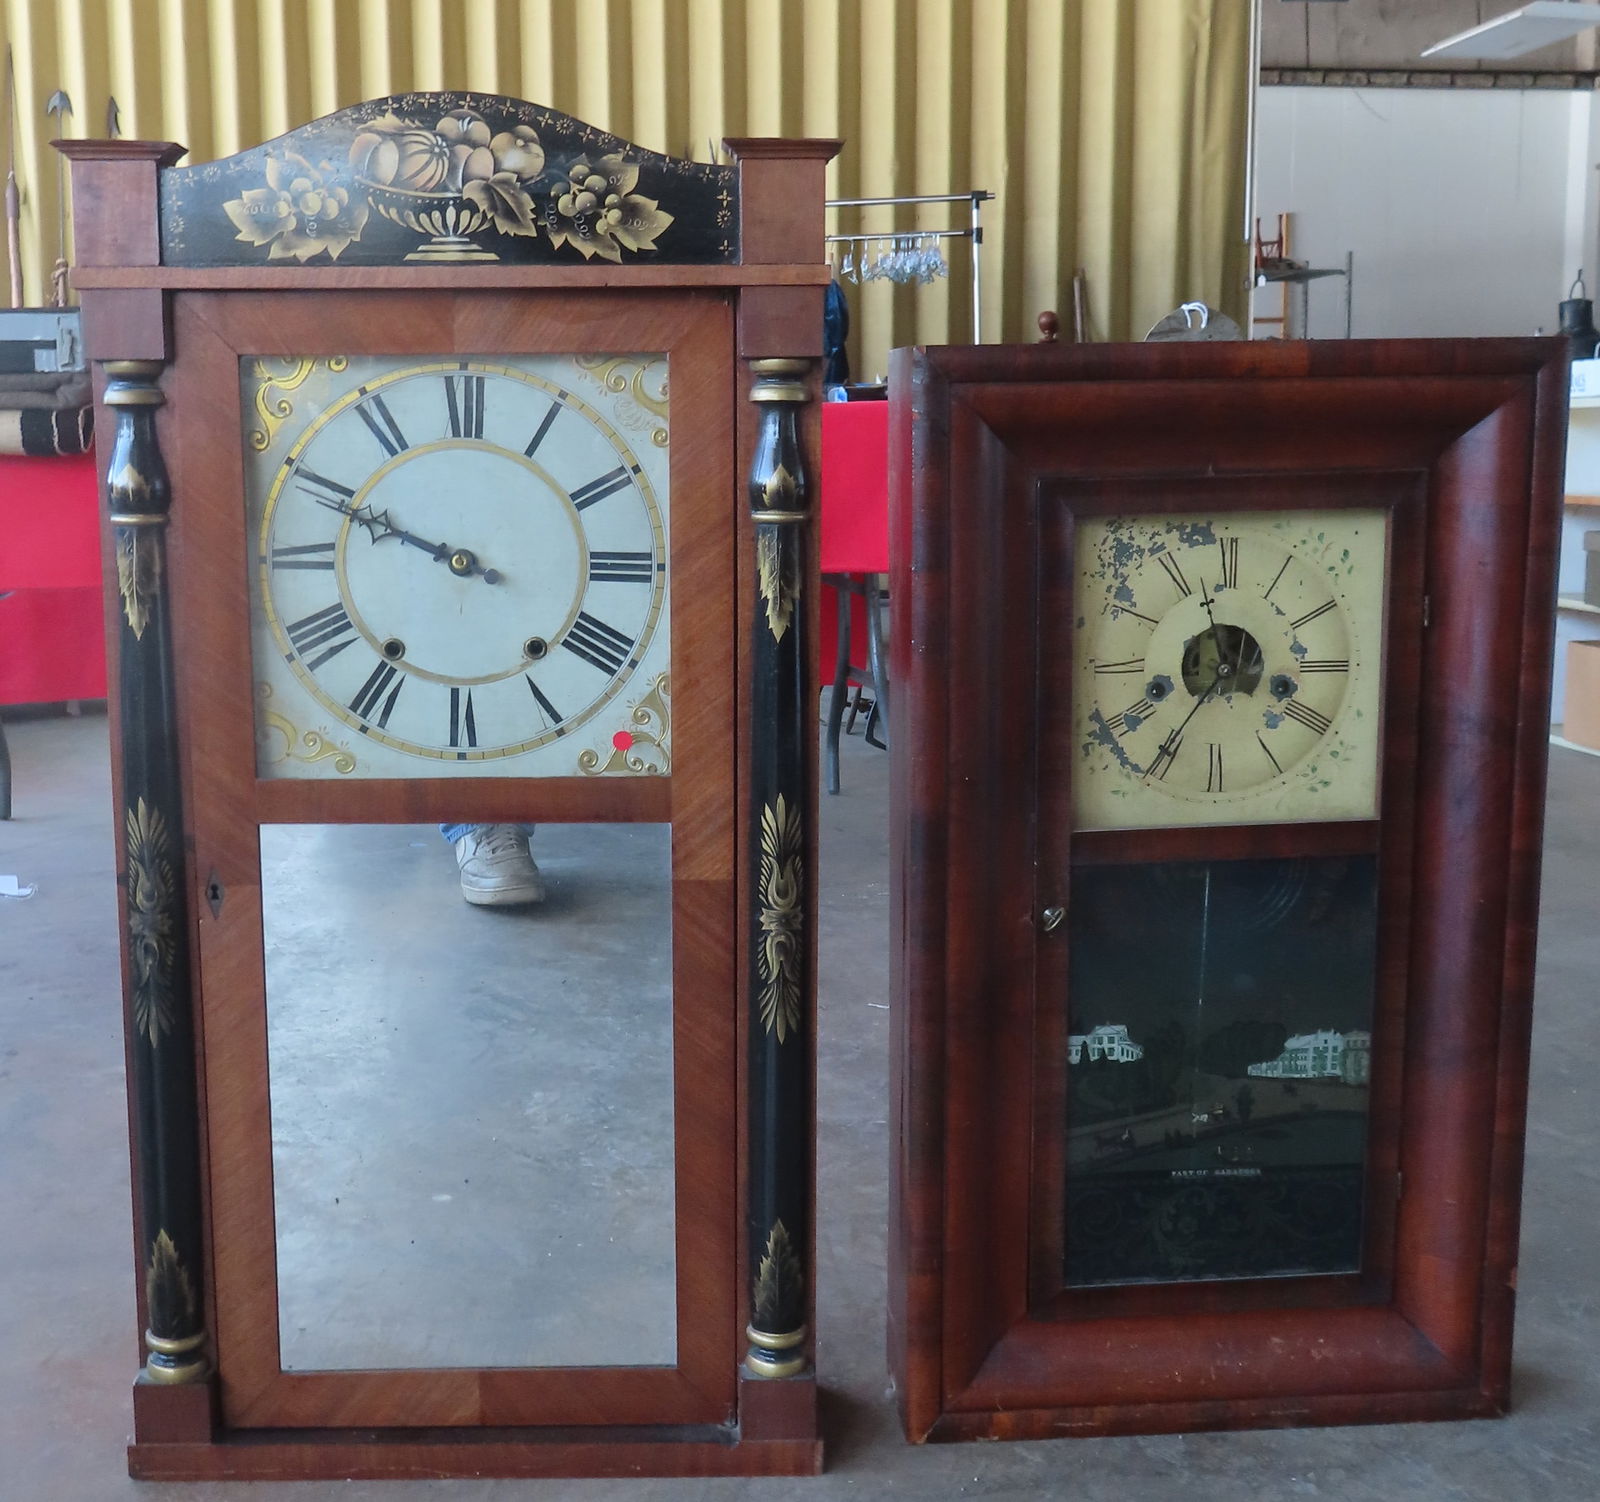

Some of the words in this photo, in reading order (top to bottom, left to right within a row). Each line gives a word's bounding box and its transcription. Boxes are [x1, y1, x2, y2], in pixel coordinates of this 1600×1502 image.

[354, 393, 410, 462] XI
[443, 375, 485, 439] XII
[524, 400, 563, 458] I
[569, 465, 634, 511] II
[271, 542, 336, 570] IX
[590, 551, 652, 583] III
[1157, 551, 1192, 601] XI
[1219, 537, 1238, 589] XII
[1262, 555, 1293, 599] I
[286, 602, 360, 673] VIII
[1290, 599, 1337, 631] II
[562, 611, 635, 677] IIII
[1094, 658, 1145, 674] IX
[1299, 660, 1349, 673] III
[348, 659, 406, 730] VII
[449, 687, 477, 748] VI
[526, 673, 564, 731] V
[1283, 699, 1332, 736] IIII
[1206, 743, 1223, 792] VI
